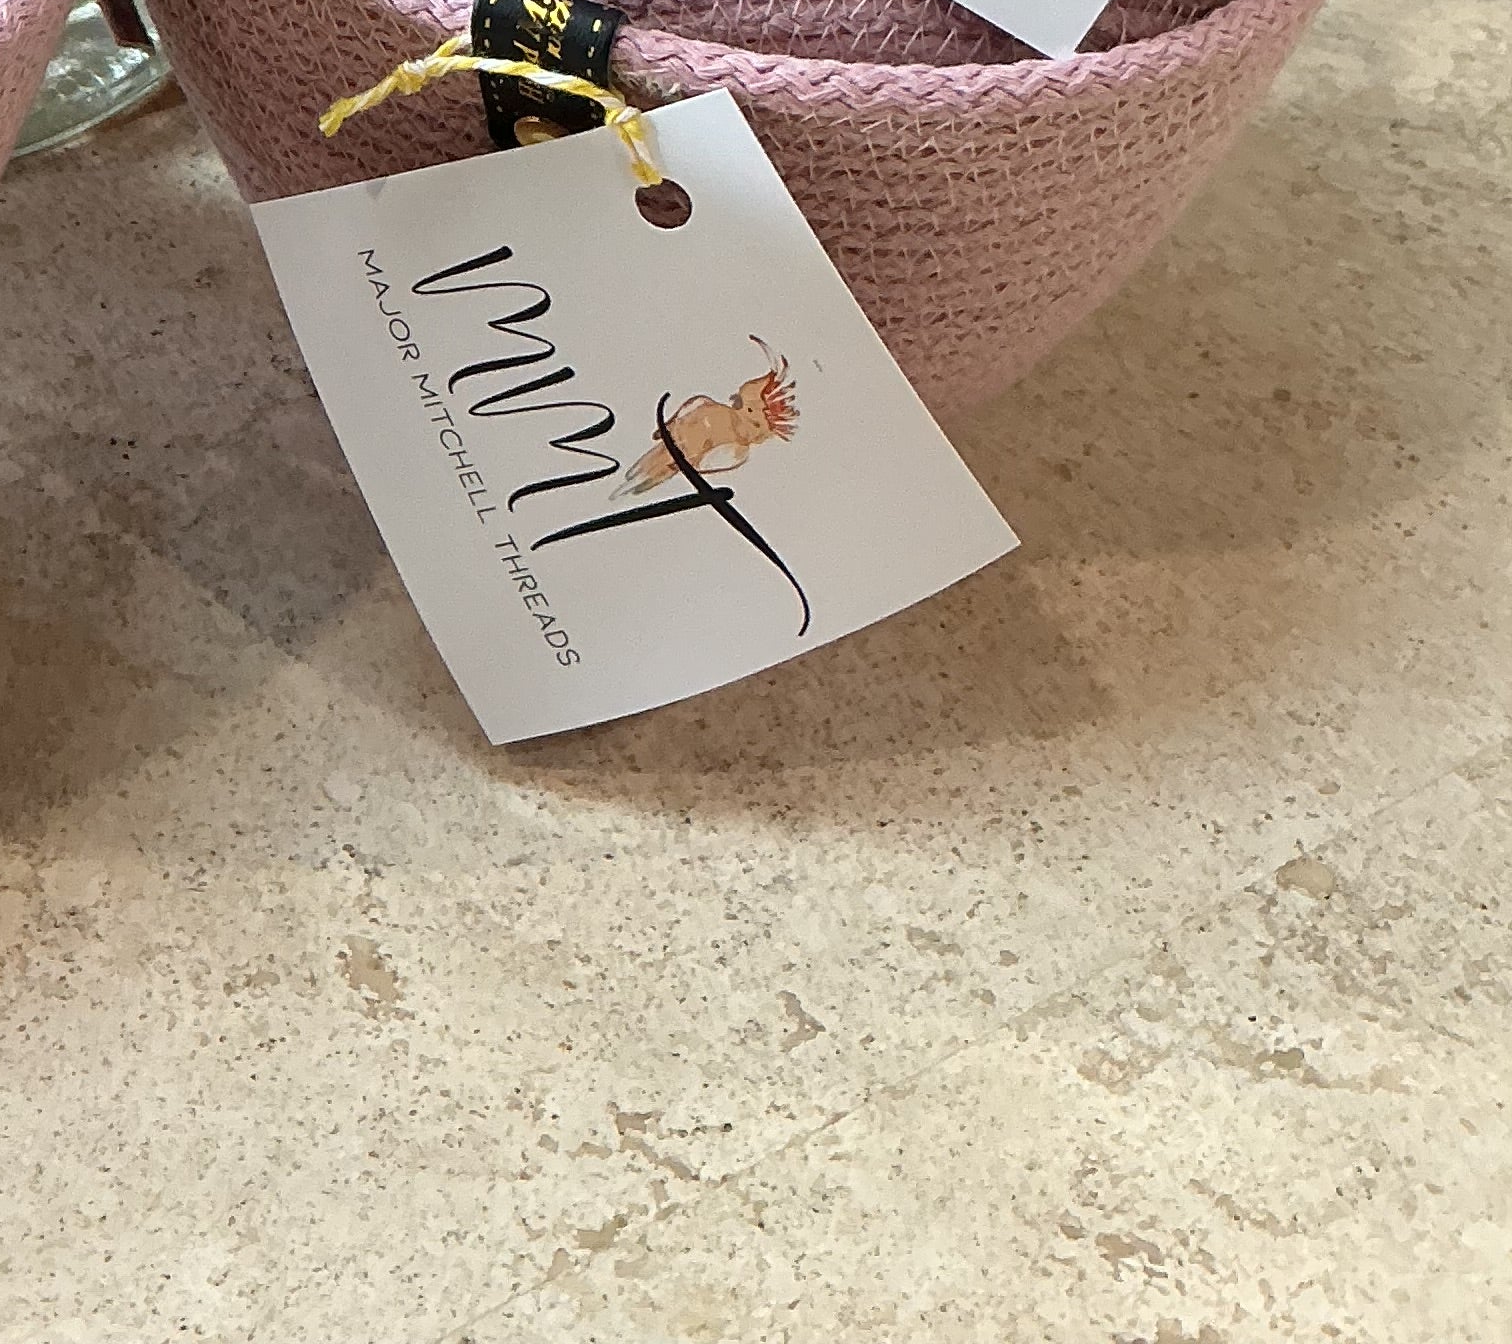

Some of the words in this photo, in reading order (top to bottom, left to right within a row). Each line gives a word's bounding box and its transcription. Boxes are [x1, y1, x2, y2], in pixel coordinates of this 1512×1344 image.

[359, 250, 420, 362] MAJOR
[412, 374, 493, 524] MITCHELL
[495, 535, 580, 666] THREADS
